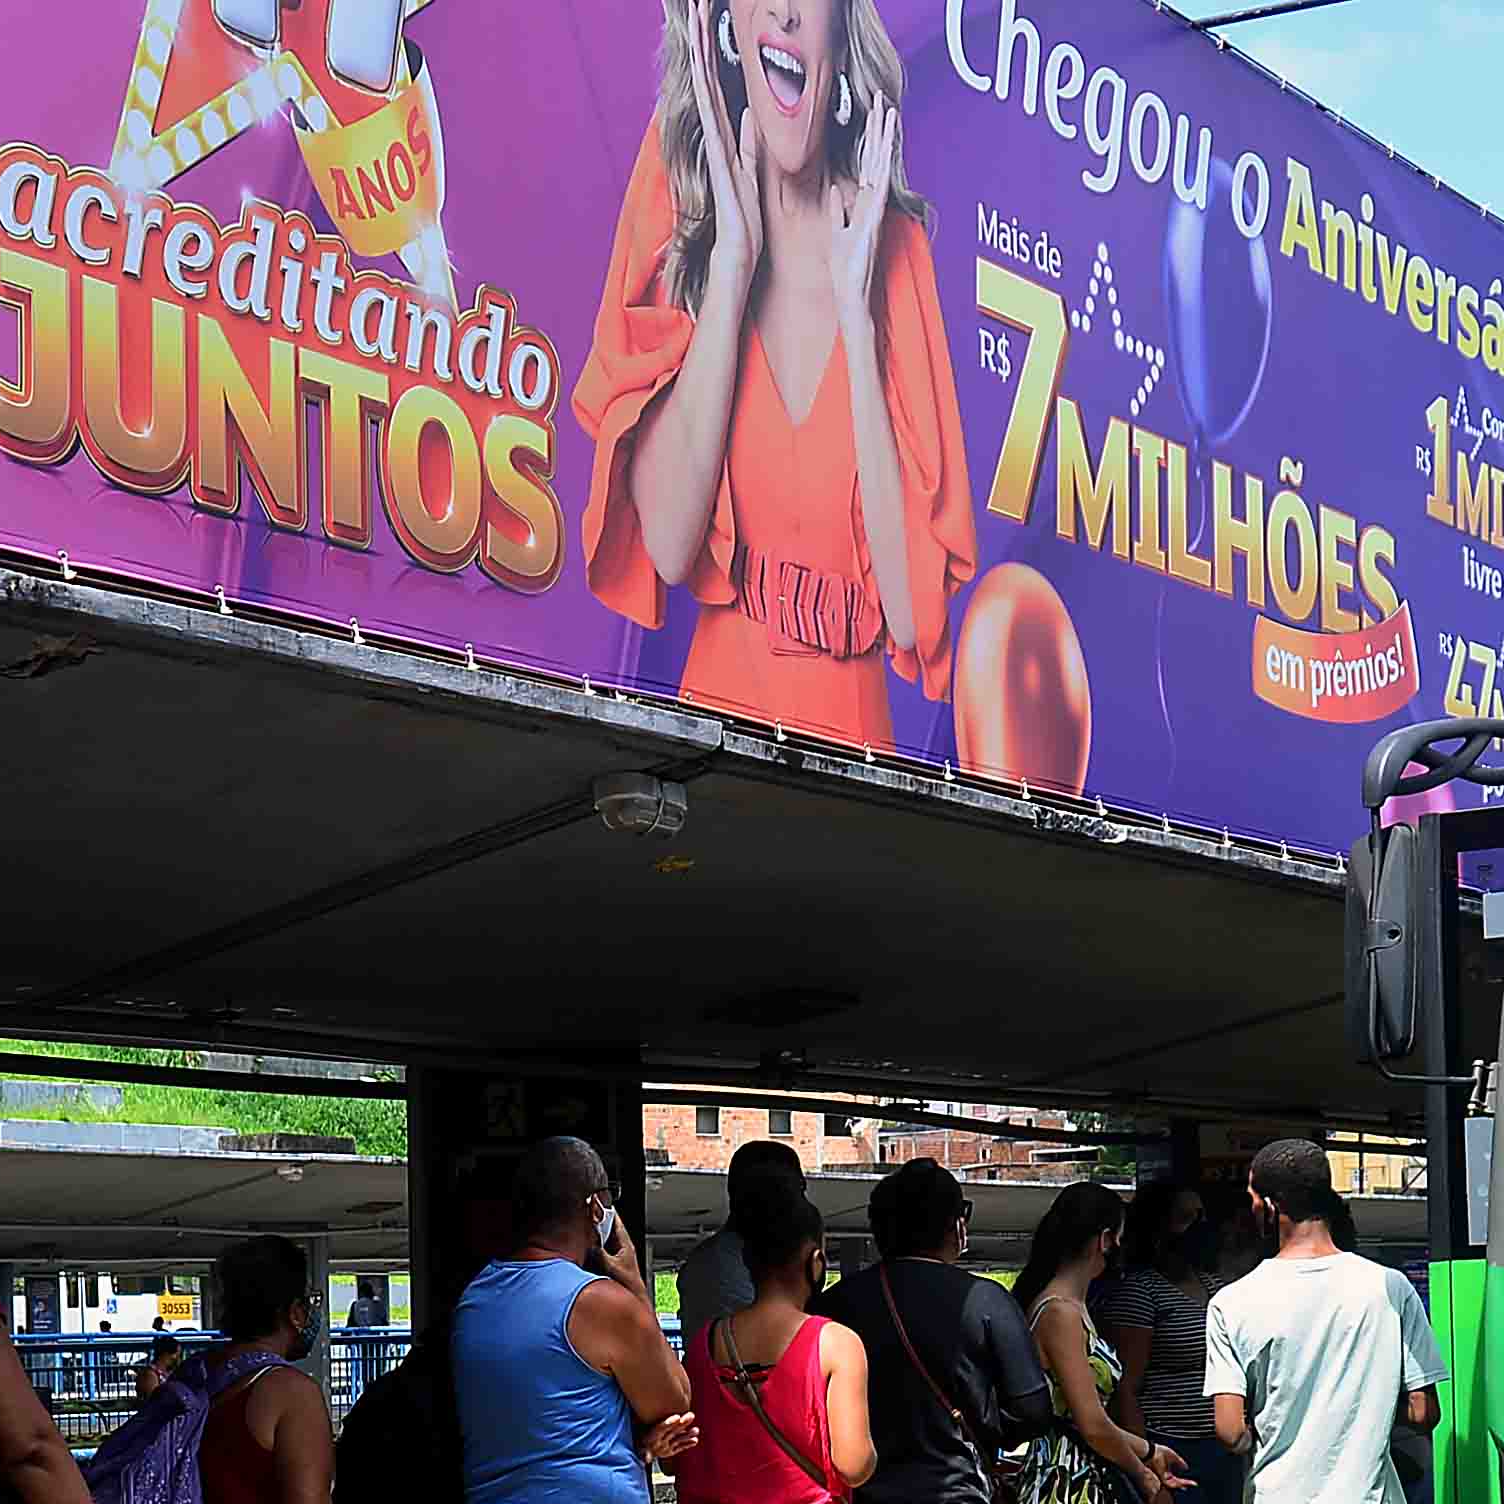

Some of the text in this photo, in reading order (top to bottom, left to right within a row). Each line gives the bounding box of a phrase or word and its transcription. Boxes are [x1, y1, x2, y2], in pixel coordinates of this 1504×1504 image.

[945, 0, 1213, 210] Chegou
[1231, 151, 1271, 239] o
[330, 105, 432, 219] ANOS
[977, 203, 1064, 279] Mais de
[974, 256, 1398, 634] R$ 7 MILHÕES
[1415, 445, 1432, 476] R$
[1426, 396, 1455, 527] 1
[1462, 546, 1502, 600] livre
[1264, 633, 1406, 707] em prêmios!
[1439, 633, 1453, 659] R$
[1445, 635, 1497, 719] 47
[161, 1303, 191, 1314] 30553
